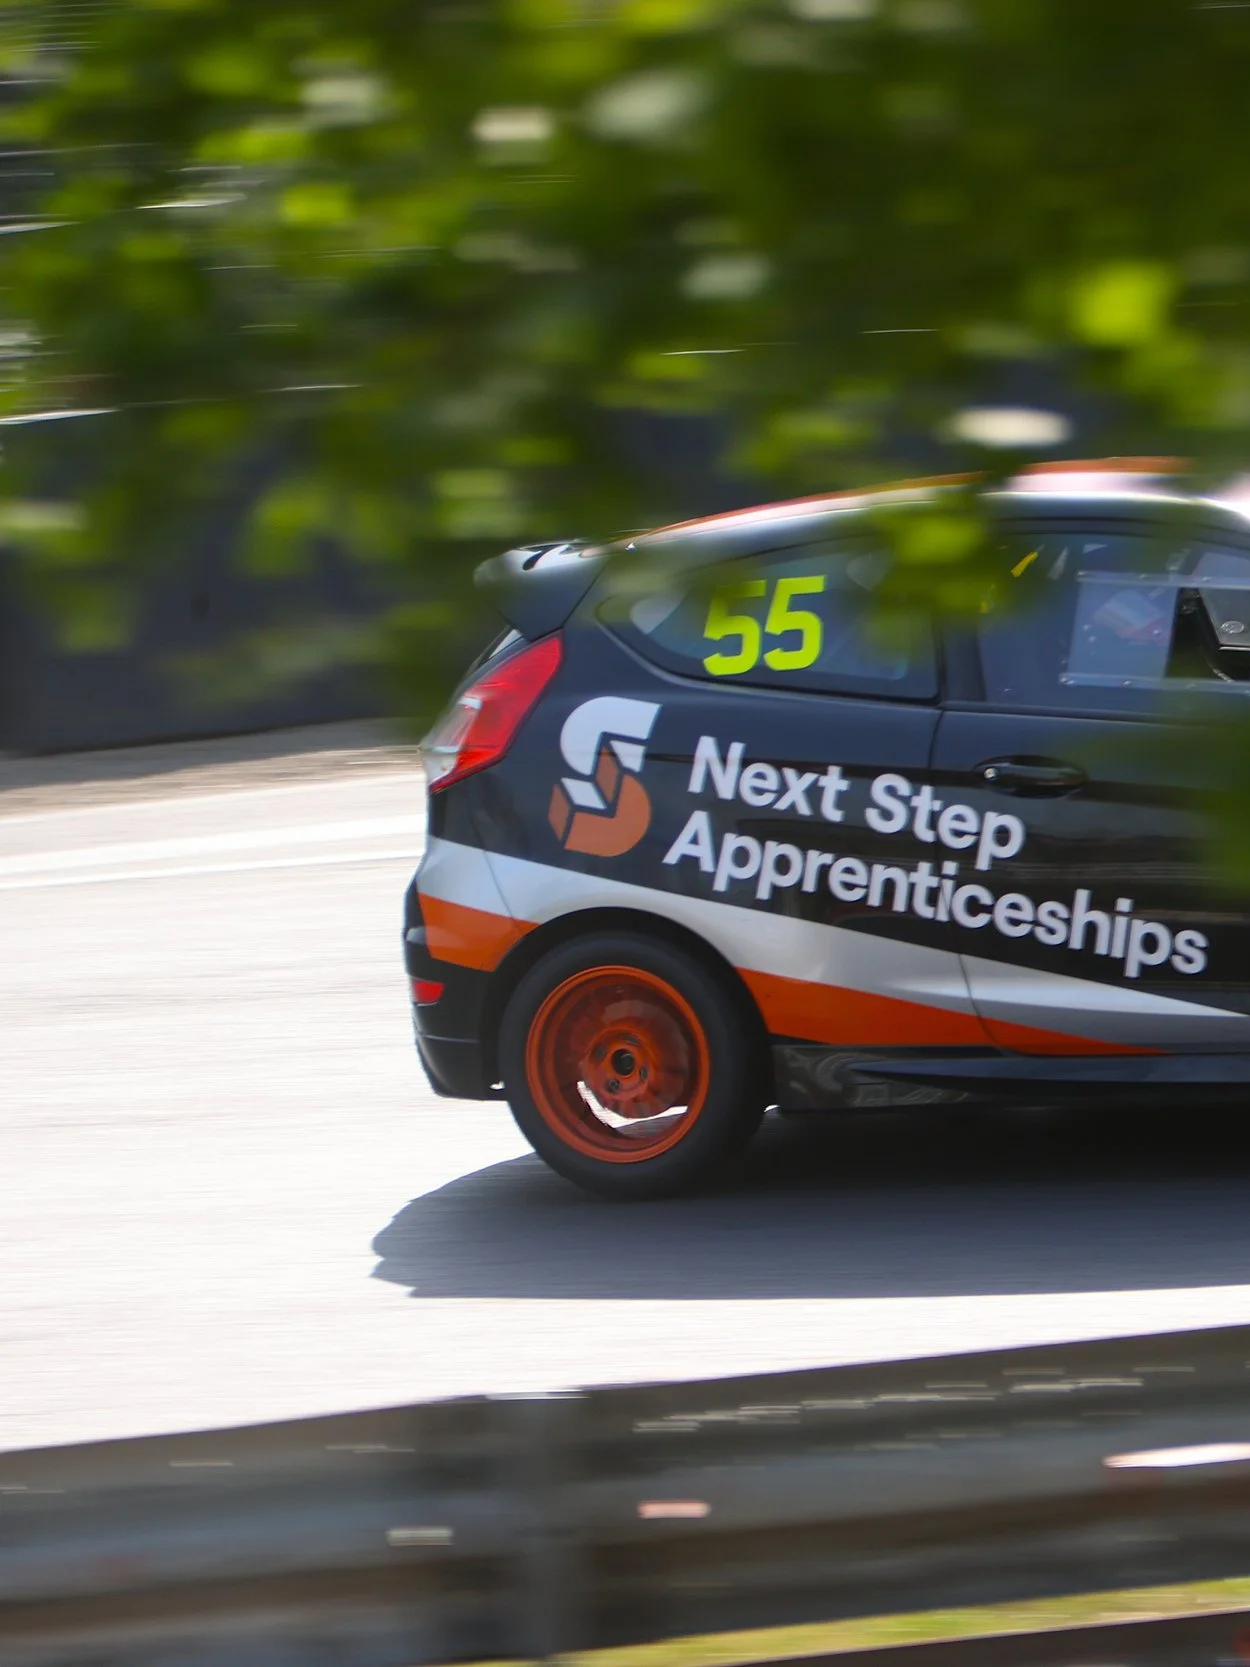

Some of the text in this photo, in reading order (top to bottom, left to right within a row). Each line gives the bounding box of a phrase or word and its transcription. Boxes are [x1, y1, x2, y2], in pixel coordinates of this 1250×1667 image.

[703, 575, 827, 677] 55
[689, 735, 1025, 870] Next Step
[662, 810, 1209, 978] Apprenticeships
